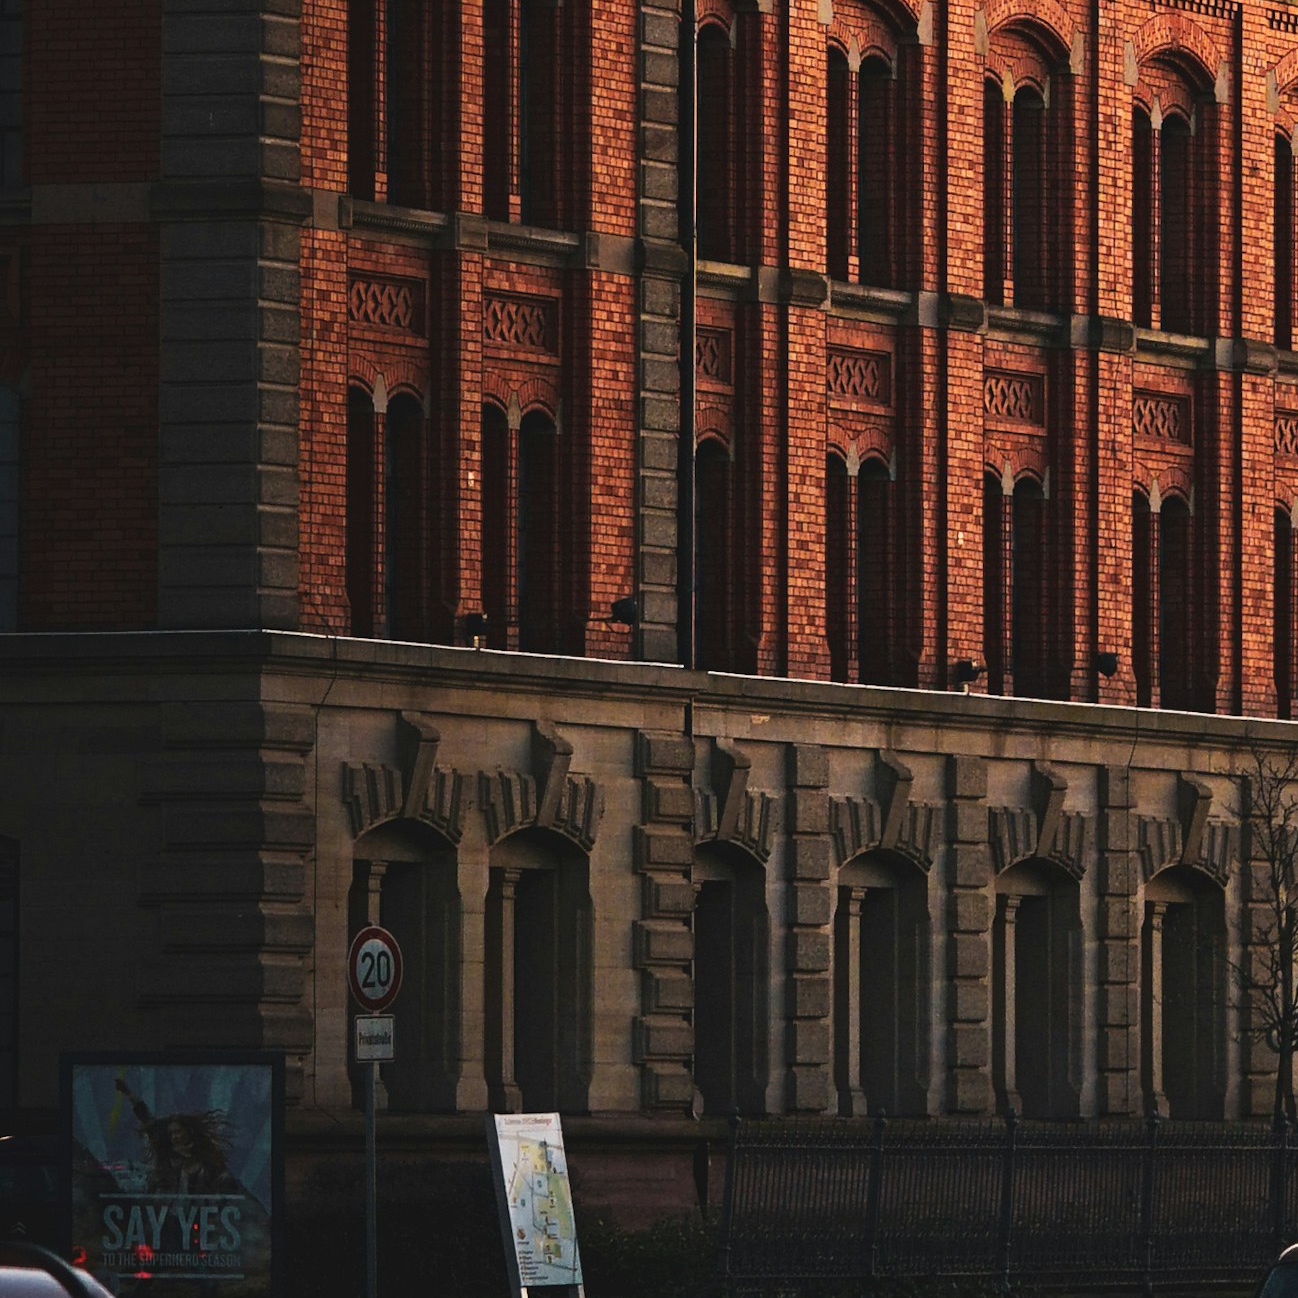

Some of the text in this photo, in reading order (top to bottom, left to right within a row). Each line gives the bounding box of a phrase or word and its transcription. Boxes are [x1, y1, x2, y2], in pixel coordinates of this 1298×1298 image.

[361, 950, 391, 988] 20
[102, 1204, 241, 1252] SAY YES
[103, 1253, 241, 1268] TO THE SUPERHERO SEASON
